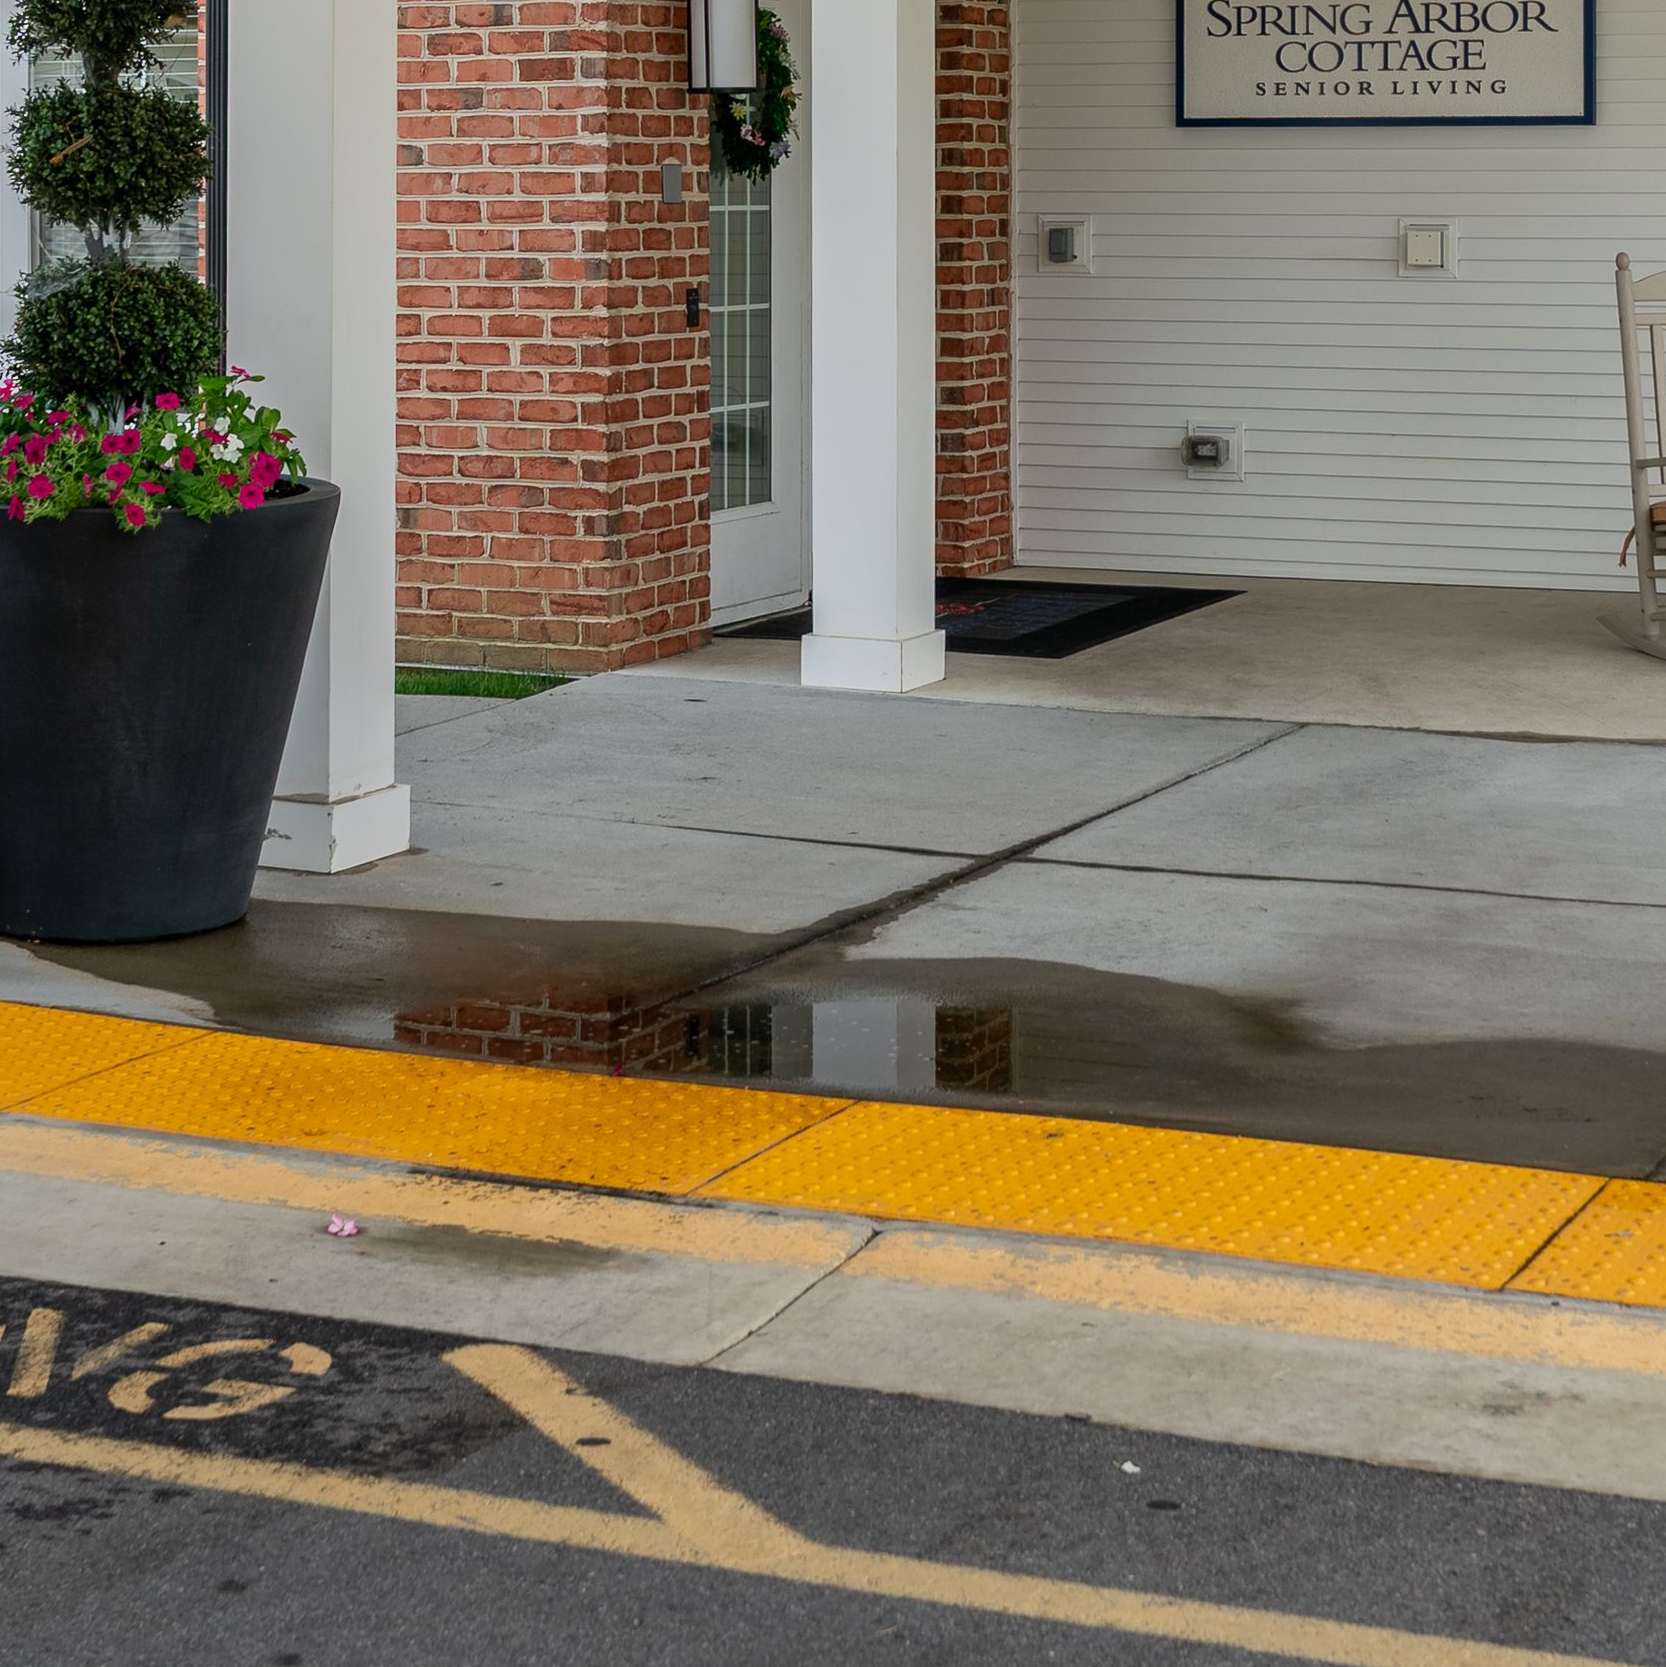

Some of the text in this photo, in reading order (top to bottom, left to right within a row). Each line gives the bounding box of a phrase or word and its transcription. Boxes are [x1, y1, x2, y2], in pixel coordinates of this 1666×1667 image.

[1275, 39, 1487, 73] COTTAGE
[1255, 79, 1508, 96] SENIOR LIVING
